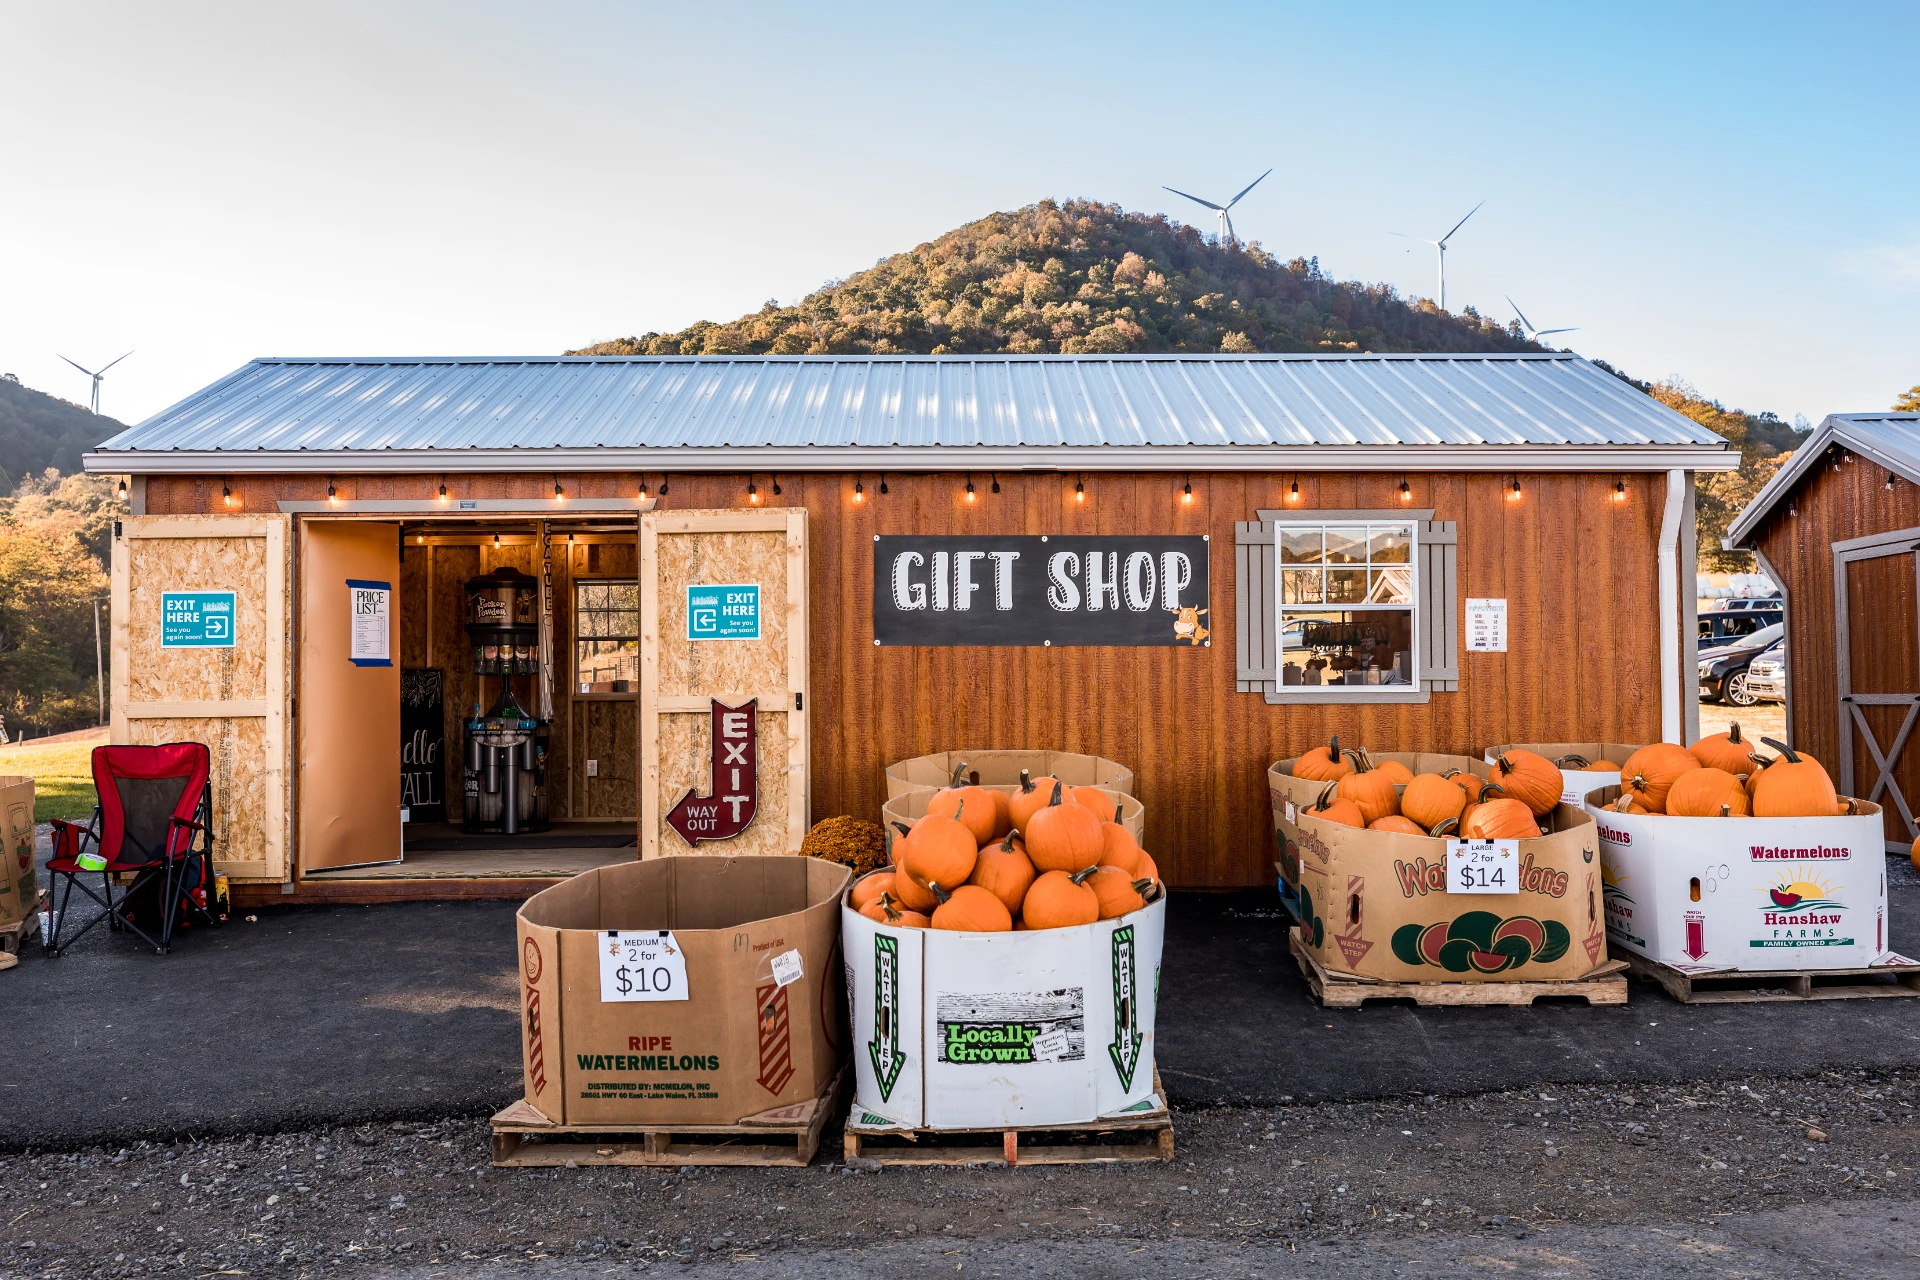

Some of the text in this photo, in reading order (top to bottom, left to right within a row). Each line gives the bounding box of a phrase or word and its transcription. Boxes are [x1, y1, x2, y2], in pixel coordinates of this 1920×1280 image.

[892, 552, 1192, 612] GIFT SHOP
[356, 590, 385, 604] PRICE
[726, 593, 756, 604] EXIT
[166, 600, 196, 611] EXIT
[356, 603, 379, 615] LIST
[722, 605, 756, 616] HERE
[166, 612, 200, 623] HERE
[742, 620, 754, 628] you
[178, 627, 191, 635] you
[165, 634, 184, 642] again
[402, 729, 443, 765] ello
[722, 712, 750, 823] EXIT
[400, 771, 441, 806] ALL
[686, 805, 718, 818] WAY
[686, 819, 718, 831] OUT
[1471, 853, 1495, 863] 2 for
[1750, 845, 1849, 859] Watermelons
[1460, 864, 1506, 890] $14
[1763, 912, 1842, 925] Hanshaw
[1773, 928, 1835, 938] FARMS
[624, 938, 659, 947] MEDIUM
[752, 938, 785, 952] Product of USA
[1340, 939, 1367, 950] WATCH
[628, 948, 657, 962] 2 for
[1343, 948, 1363, 957] STEP
[1120, 947, 1129, 999] WATC
[615, 964, 672, 997] $10
[881, 956, 890, 1007] WATC
[947, 1024, 1039, 1047] Locally
[1035, 1034, 1064, 1046] Supporting
[628, 1036, 672, 1051] RIPE
[1043, 1041, 1058, 1049] Local
[947, 1042, 1031, 1061] Grown
[577, 1054, 720, 1071] WATERMELONS
[587, 1082, 711, 1091] DISTRIBUTED BY: MCMELON, INC
[665, 1092, 687, 1100] Wales,
